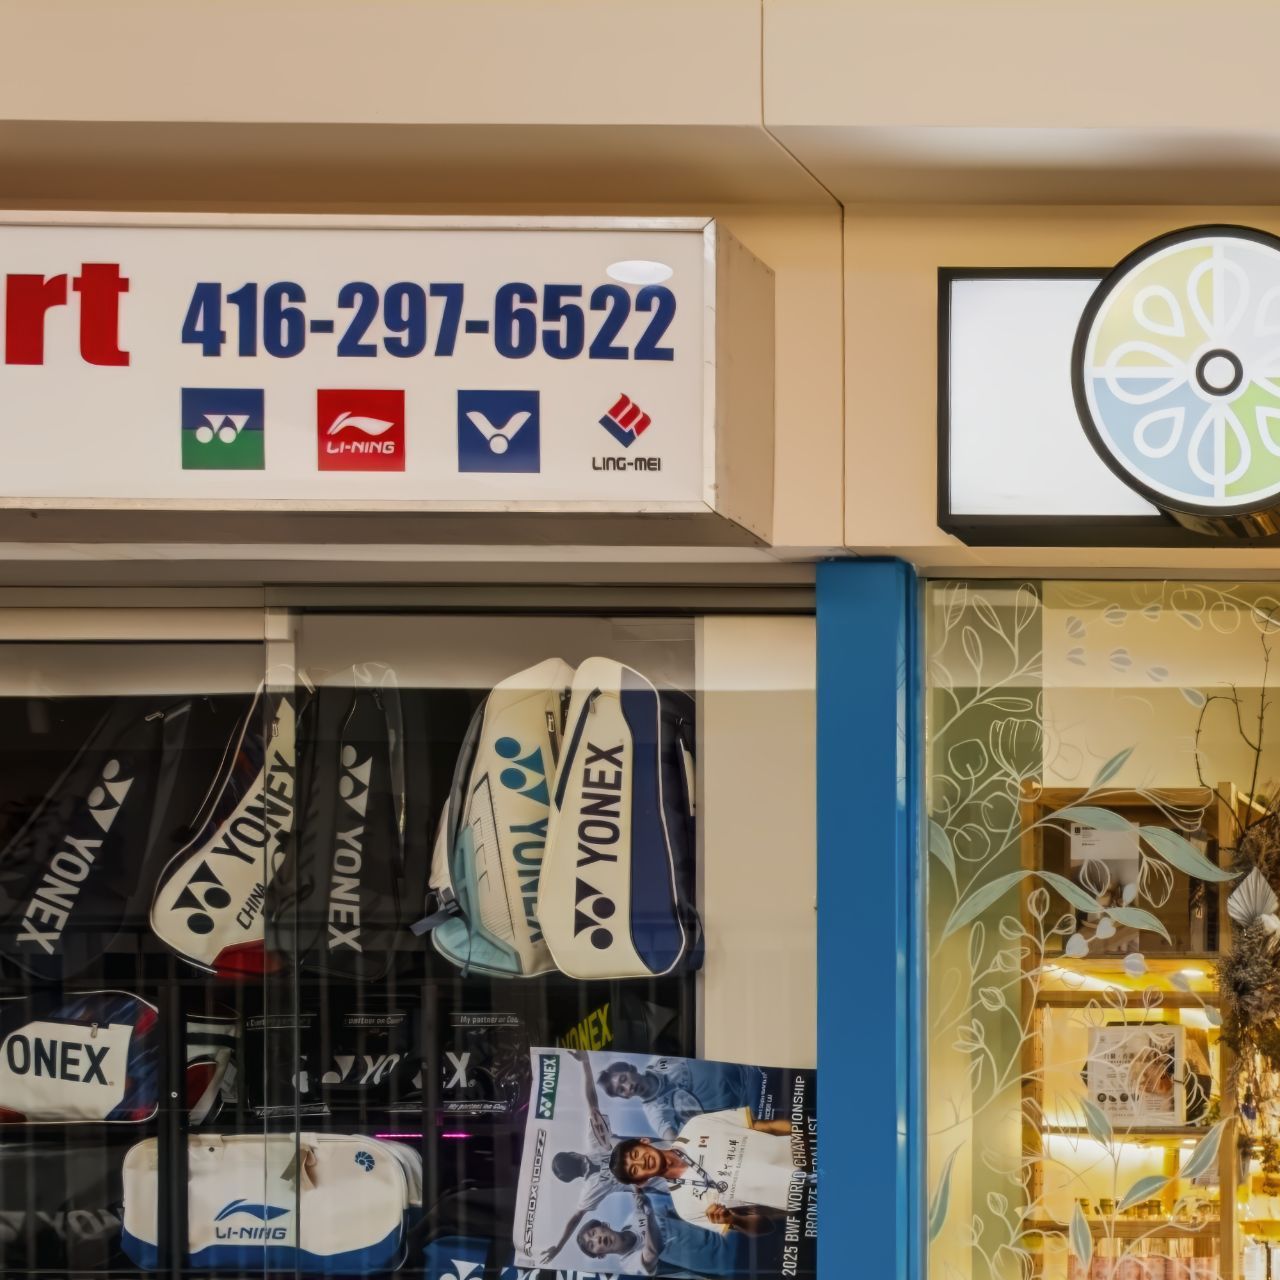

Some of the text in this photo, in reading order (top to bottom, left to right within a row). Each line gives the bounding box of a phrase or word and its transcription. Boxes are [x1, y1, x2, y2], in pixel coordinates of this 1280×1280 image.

[181, 281, 677, 361] 416-297-6522
[326, 440, 396, 455] LI-NING
[592, 456, 661, 471] LING-MEI
[576, 742, 624, 868] YONEX
[16, 835, 103, 955] YONEX
[236, 882, 266, 931] CHINA
[327, 825, 366, 952] YONEX
[541, 1058, 557, 1094] YONEX
[782, 1075, 806, 1277] 2025 BWF WORLD CHAMPIONSHIP
[215, 1226, 287, 1240] LI-NING
[523, 1184, 539, 1258] ASTROX
